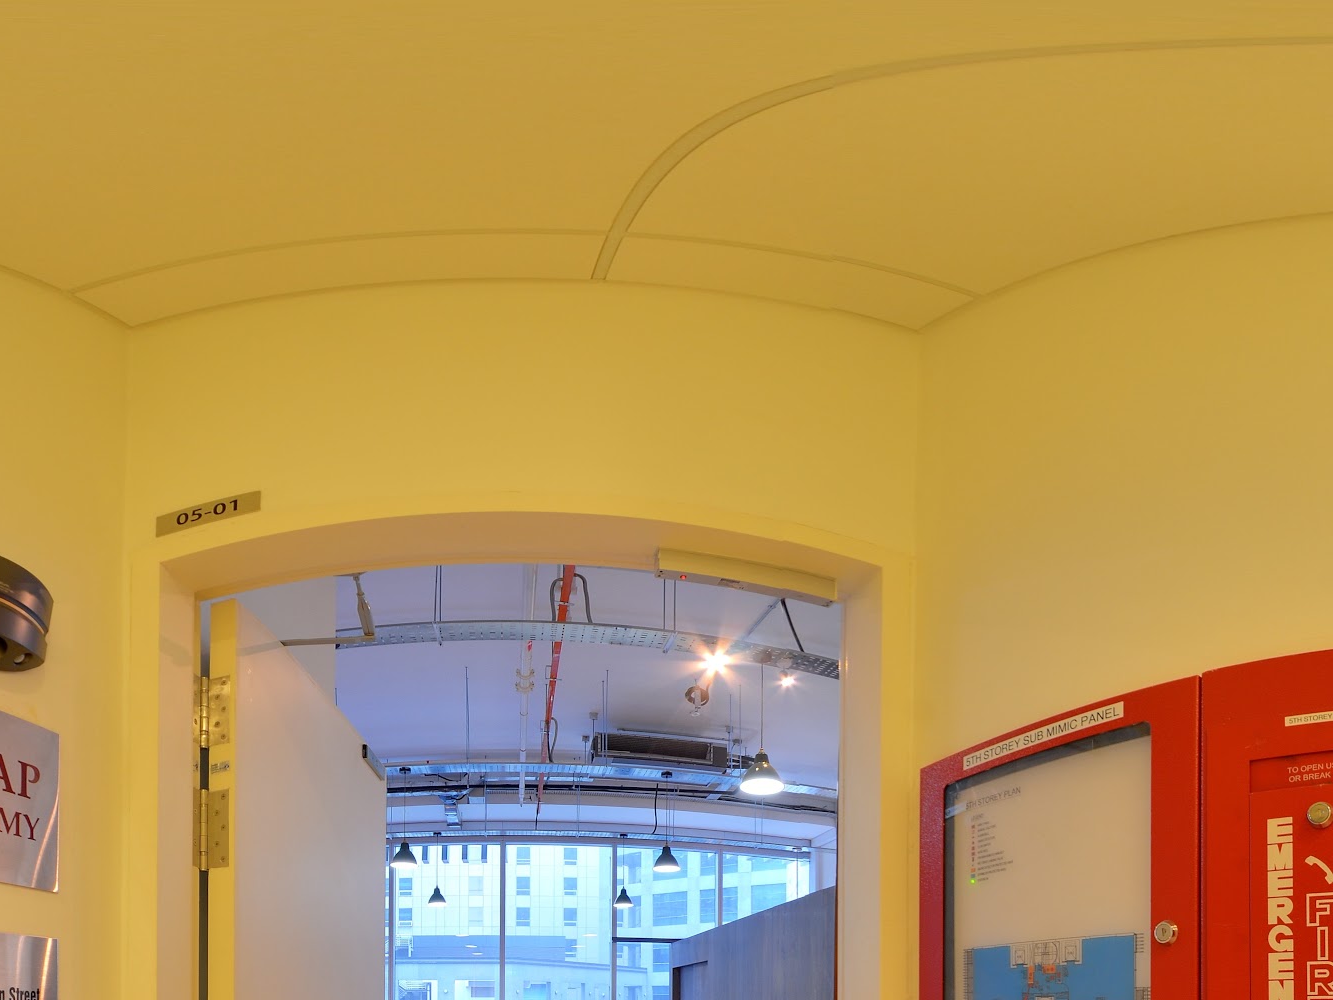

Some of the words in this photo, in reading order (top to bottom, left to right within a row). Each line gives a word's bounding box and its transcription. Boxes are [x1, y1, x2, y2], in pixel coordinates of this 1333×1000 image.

[176, 499, 238, 525] 05-01
[1289, 717, 1303, 725] 5TH
[1303, 713, 1333, 722] STOREY
[965, 754, 982, 767] 5TH
[983, 738, 1021, 760] STOREY
[1023, 731, 1044, 746] SUB
[1046, 719, 1078, 738] MIMIC
[1080, 706, 1120, 727] PANEL
[1300, 763, 1324, 772] OPEN
[1288, 774, 1301, 783] OR
[1303, 771, 1331, 781] BREAK
